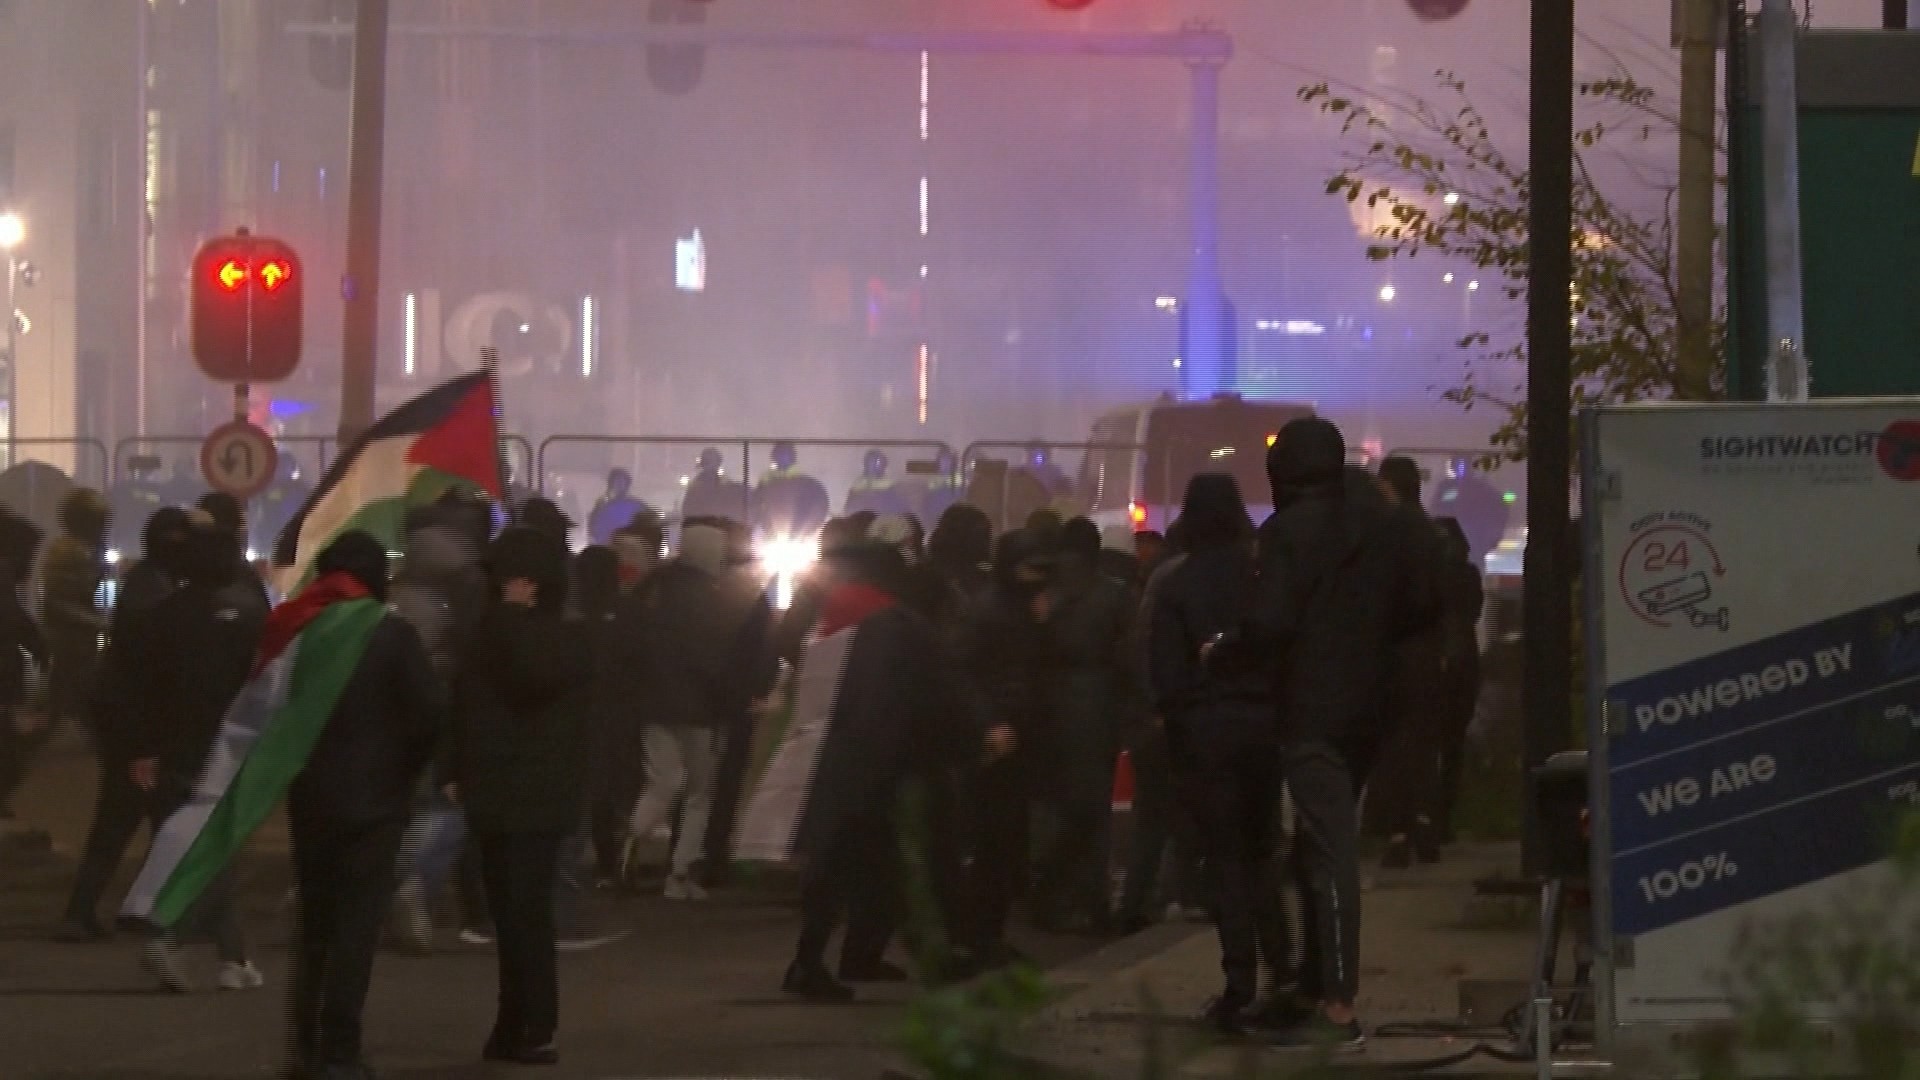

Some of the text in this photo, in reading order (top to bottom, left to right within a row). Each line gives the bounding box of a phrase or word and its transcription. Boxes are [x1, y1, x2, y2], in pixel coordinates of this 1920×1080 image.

[1701, 433, 1873, 458] SIGHTWATCH
[1644, 540, 1689, 571] 24
[1813, 642, 1853, 679] BY
[1637, 852, 1739, 903] 100%
